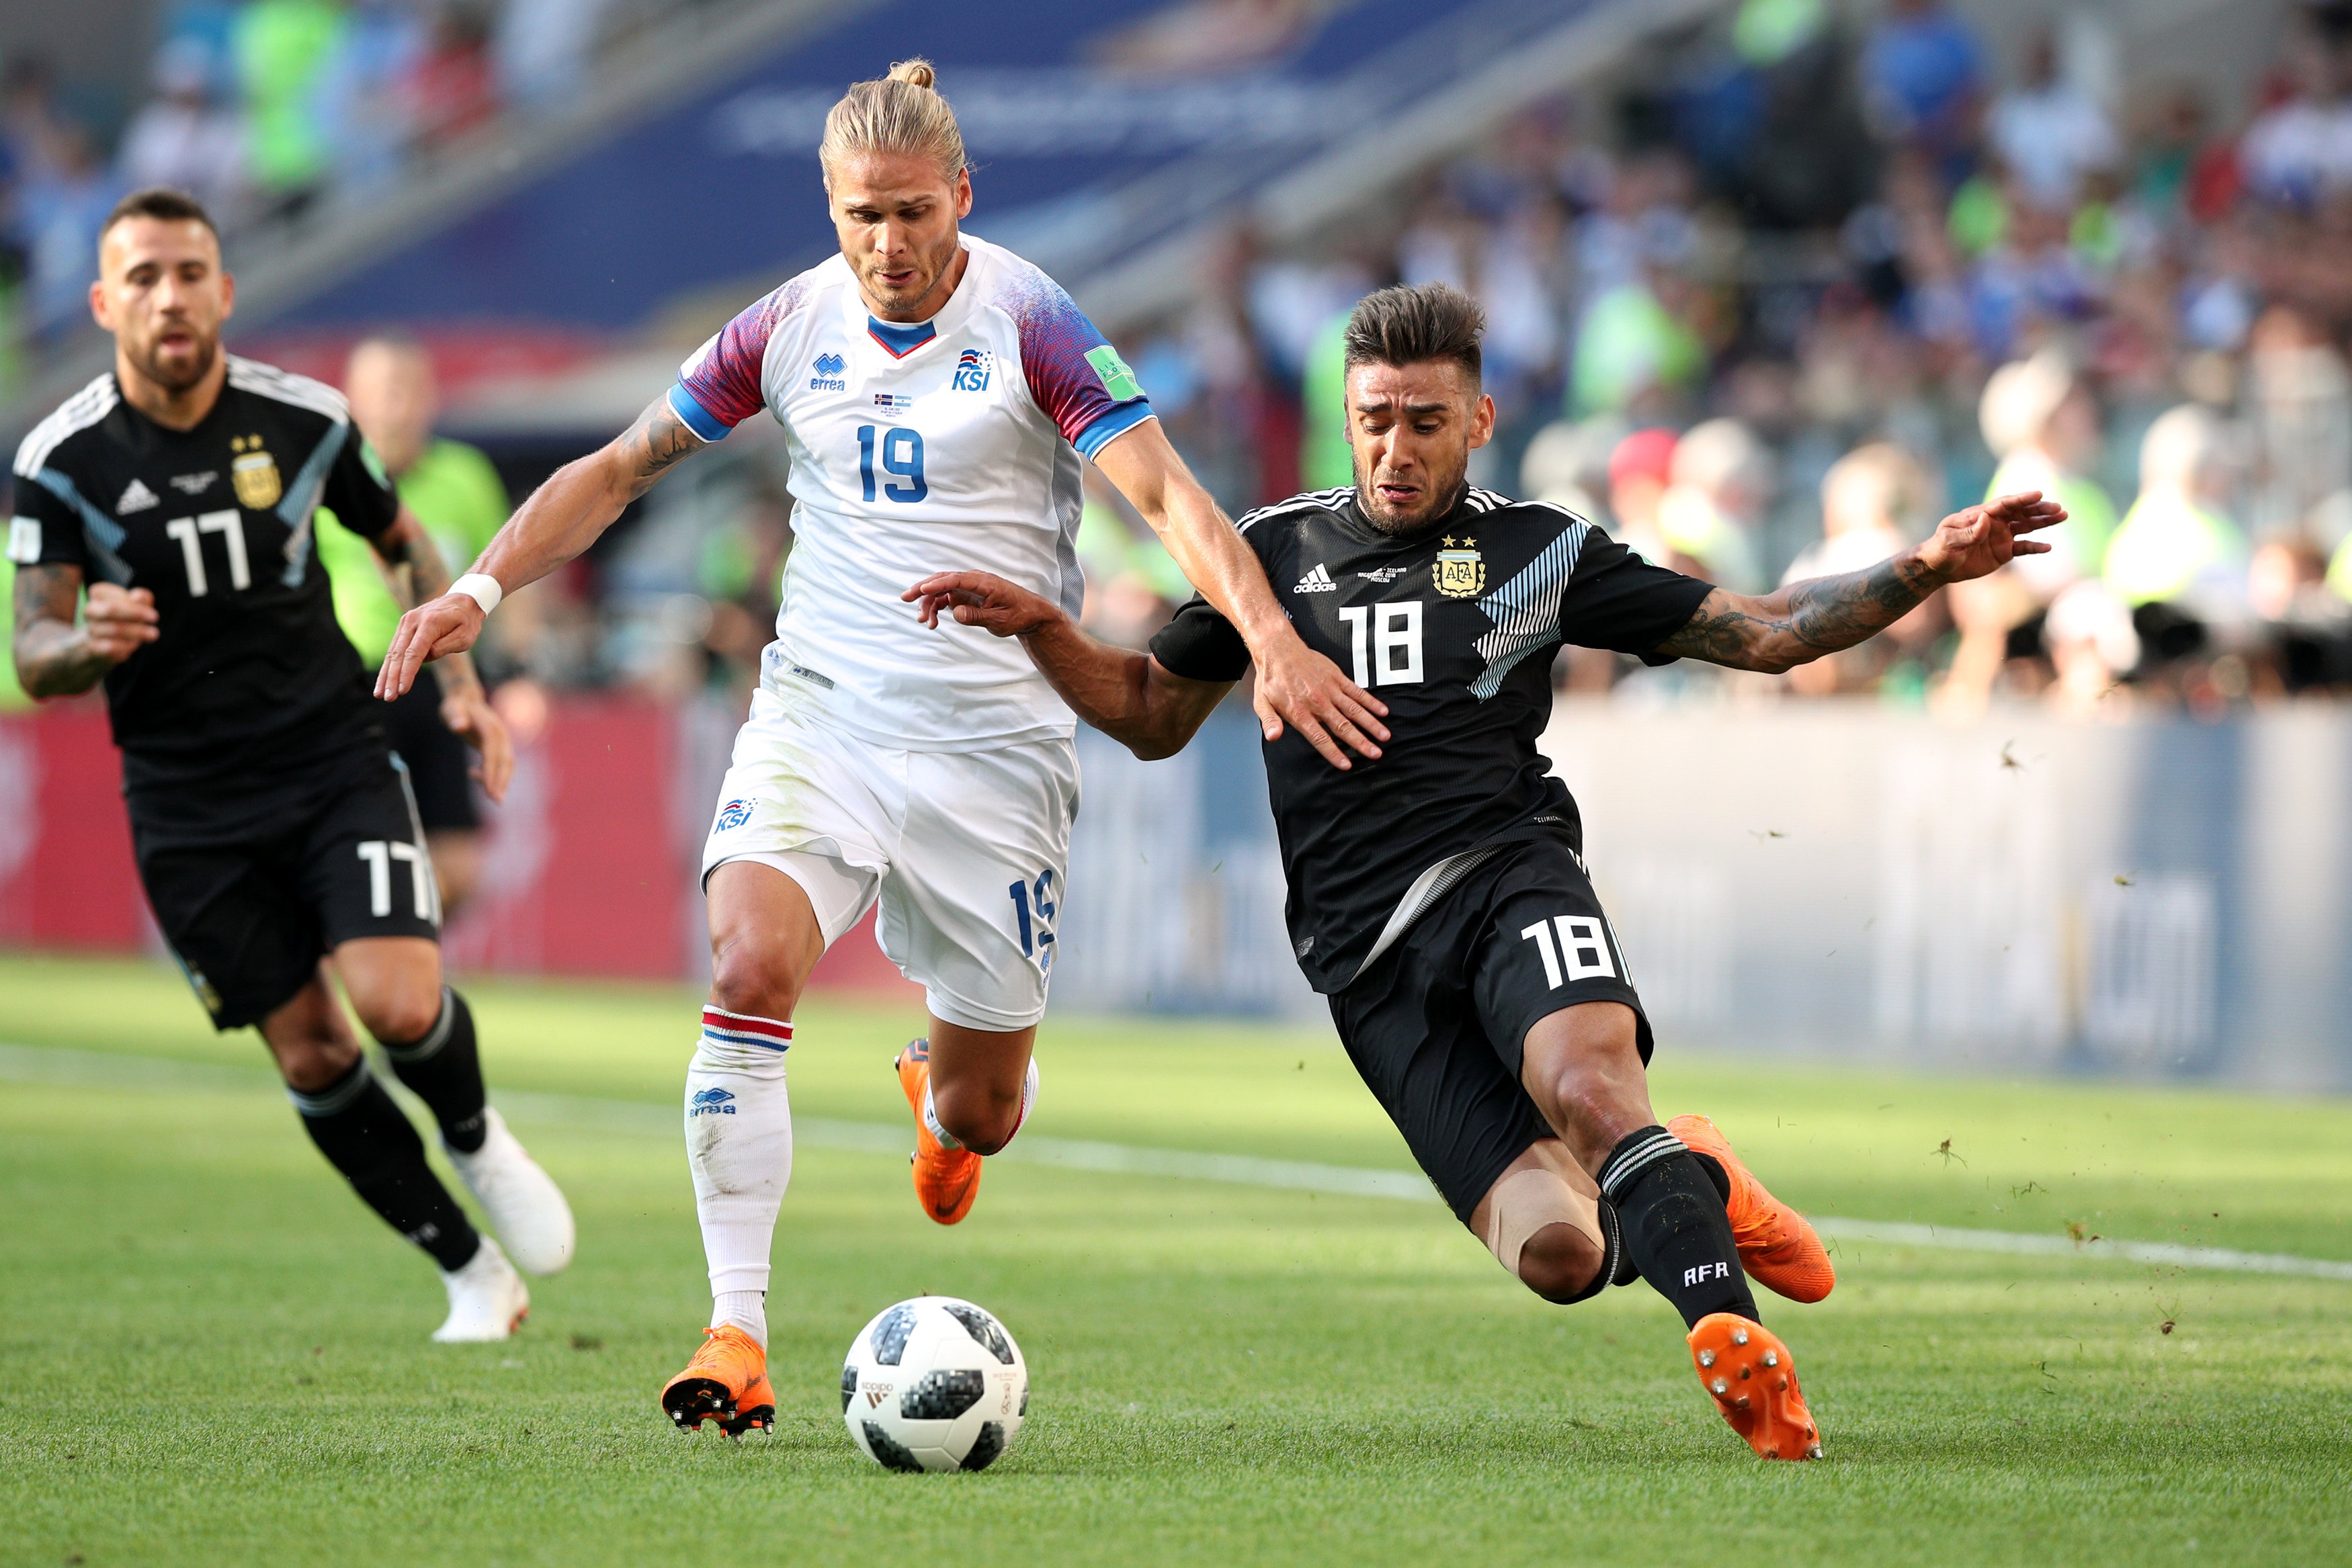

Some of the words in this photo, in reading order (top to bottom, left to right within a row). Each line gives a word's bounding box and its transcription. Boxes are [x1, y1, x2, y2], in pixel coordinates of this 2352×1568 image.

[810, 378, 845, 391] errea
[857, 425, 928, 503] 19
[165, 508, 251, 597] 17
[1445, 561, 1474, 584] AFA
[1293, 582, 1337, 594] adidas
[1339, 601, 1424, 689] 18
[356, 840, 431, 920] 17
[1009, 869, 1056, 959] 19
[1521, 915, 1617, 991] 18
[689, 1104, 736, 1118] errea
[1684, 1262, 1730, 1288] AFA
[862, 1382, 894, 1393] adidas
